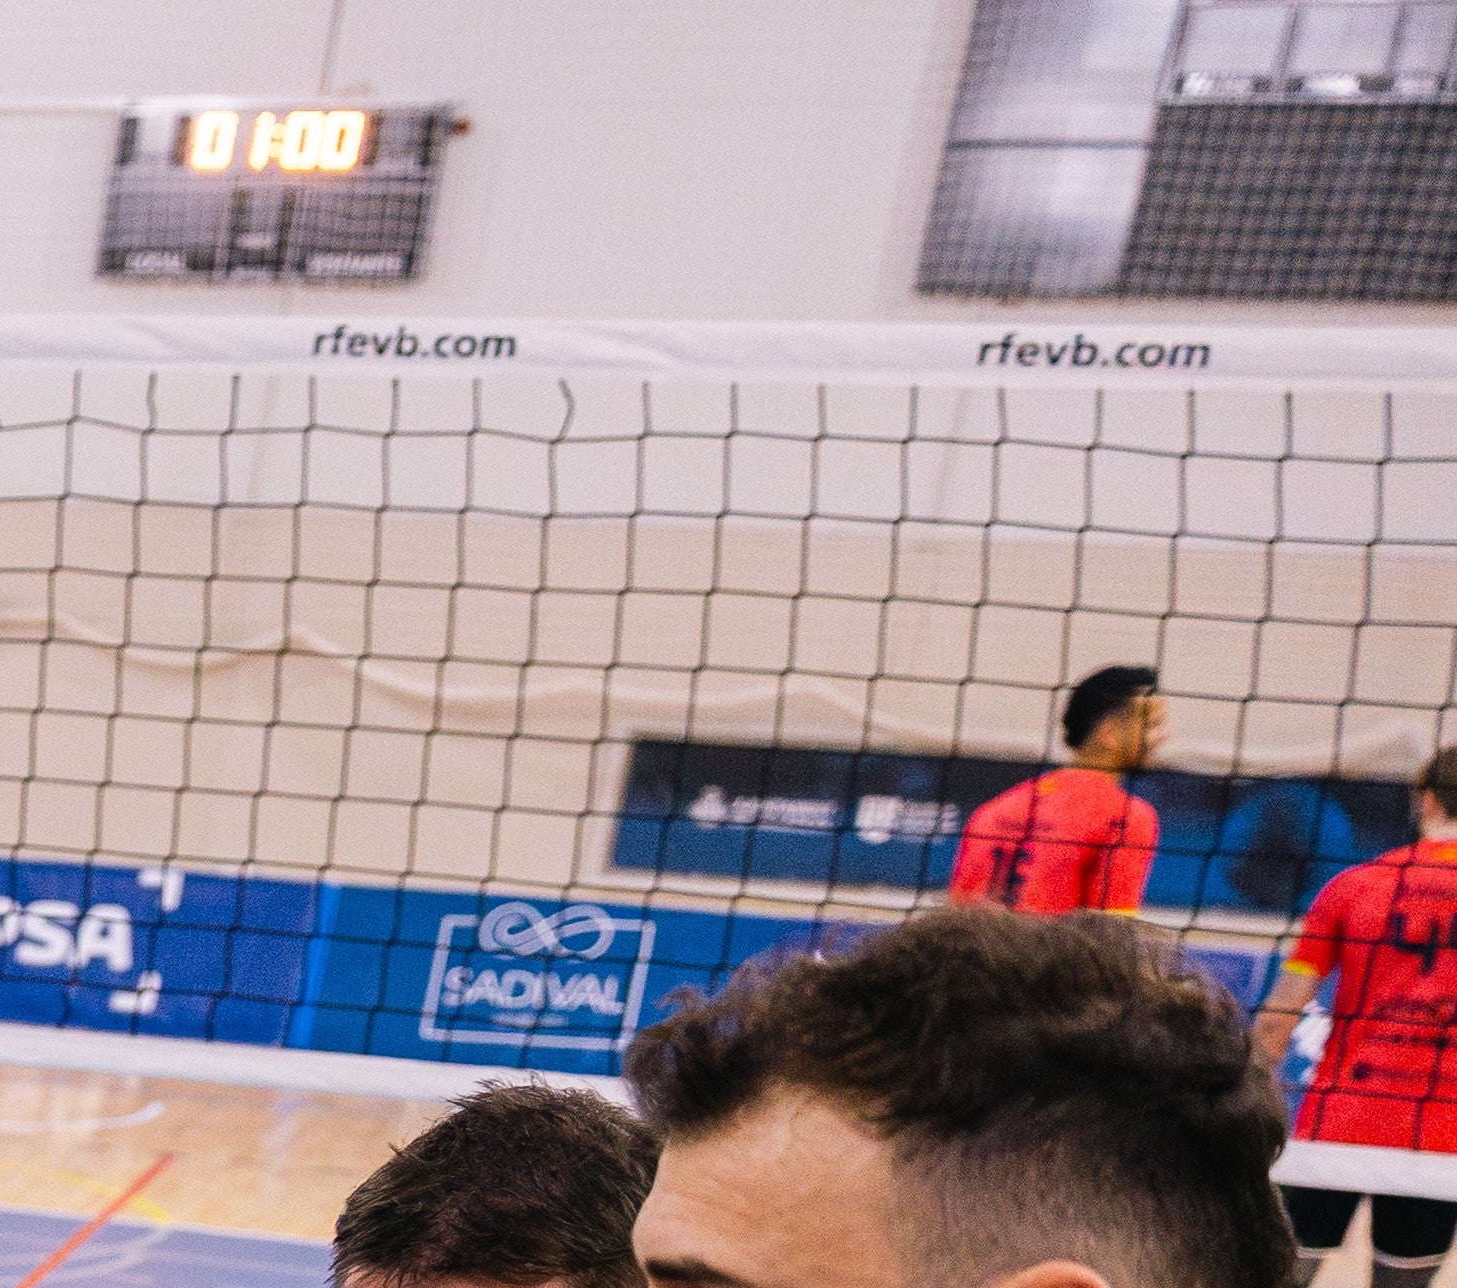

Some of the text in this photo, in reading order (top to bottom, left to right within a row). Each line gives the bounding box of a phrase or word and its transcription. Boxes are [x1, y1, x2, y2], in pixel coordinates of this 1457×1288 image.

[190, 110, 367, 171] 01:00
[313, 324, 517, 359] rfevb.com
[976, 330, 1212, 368] rfevb.com
[444, 965, 626, 1016] SADIVAL
